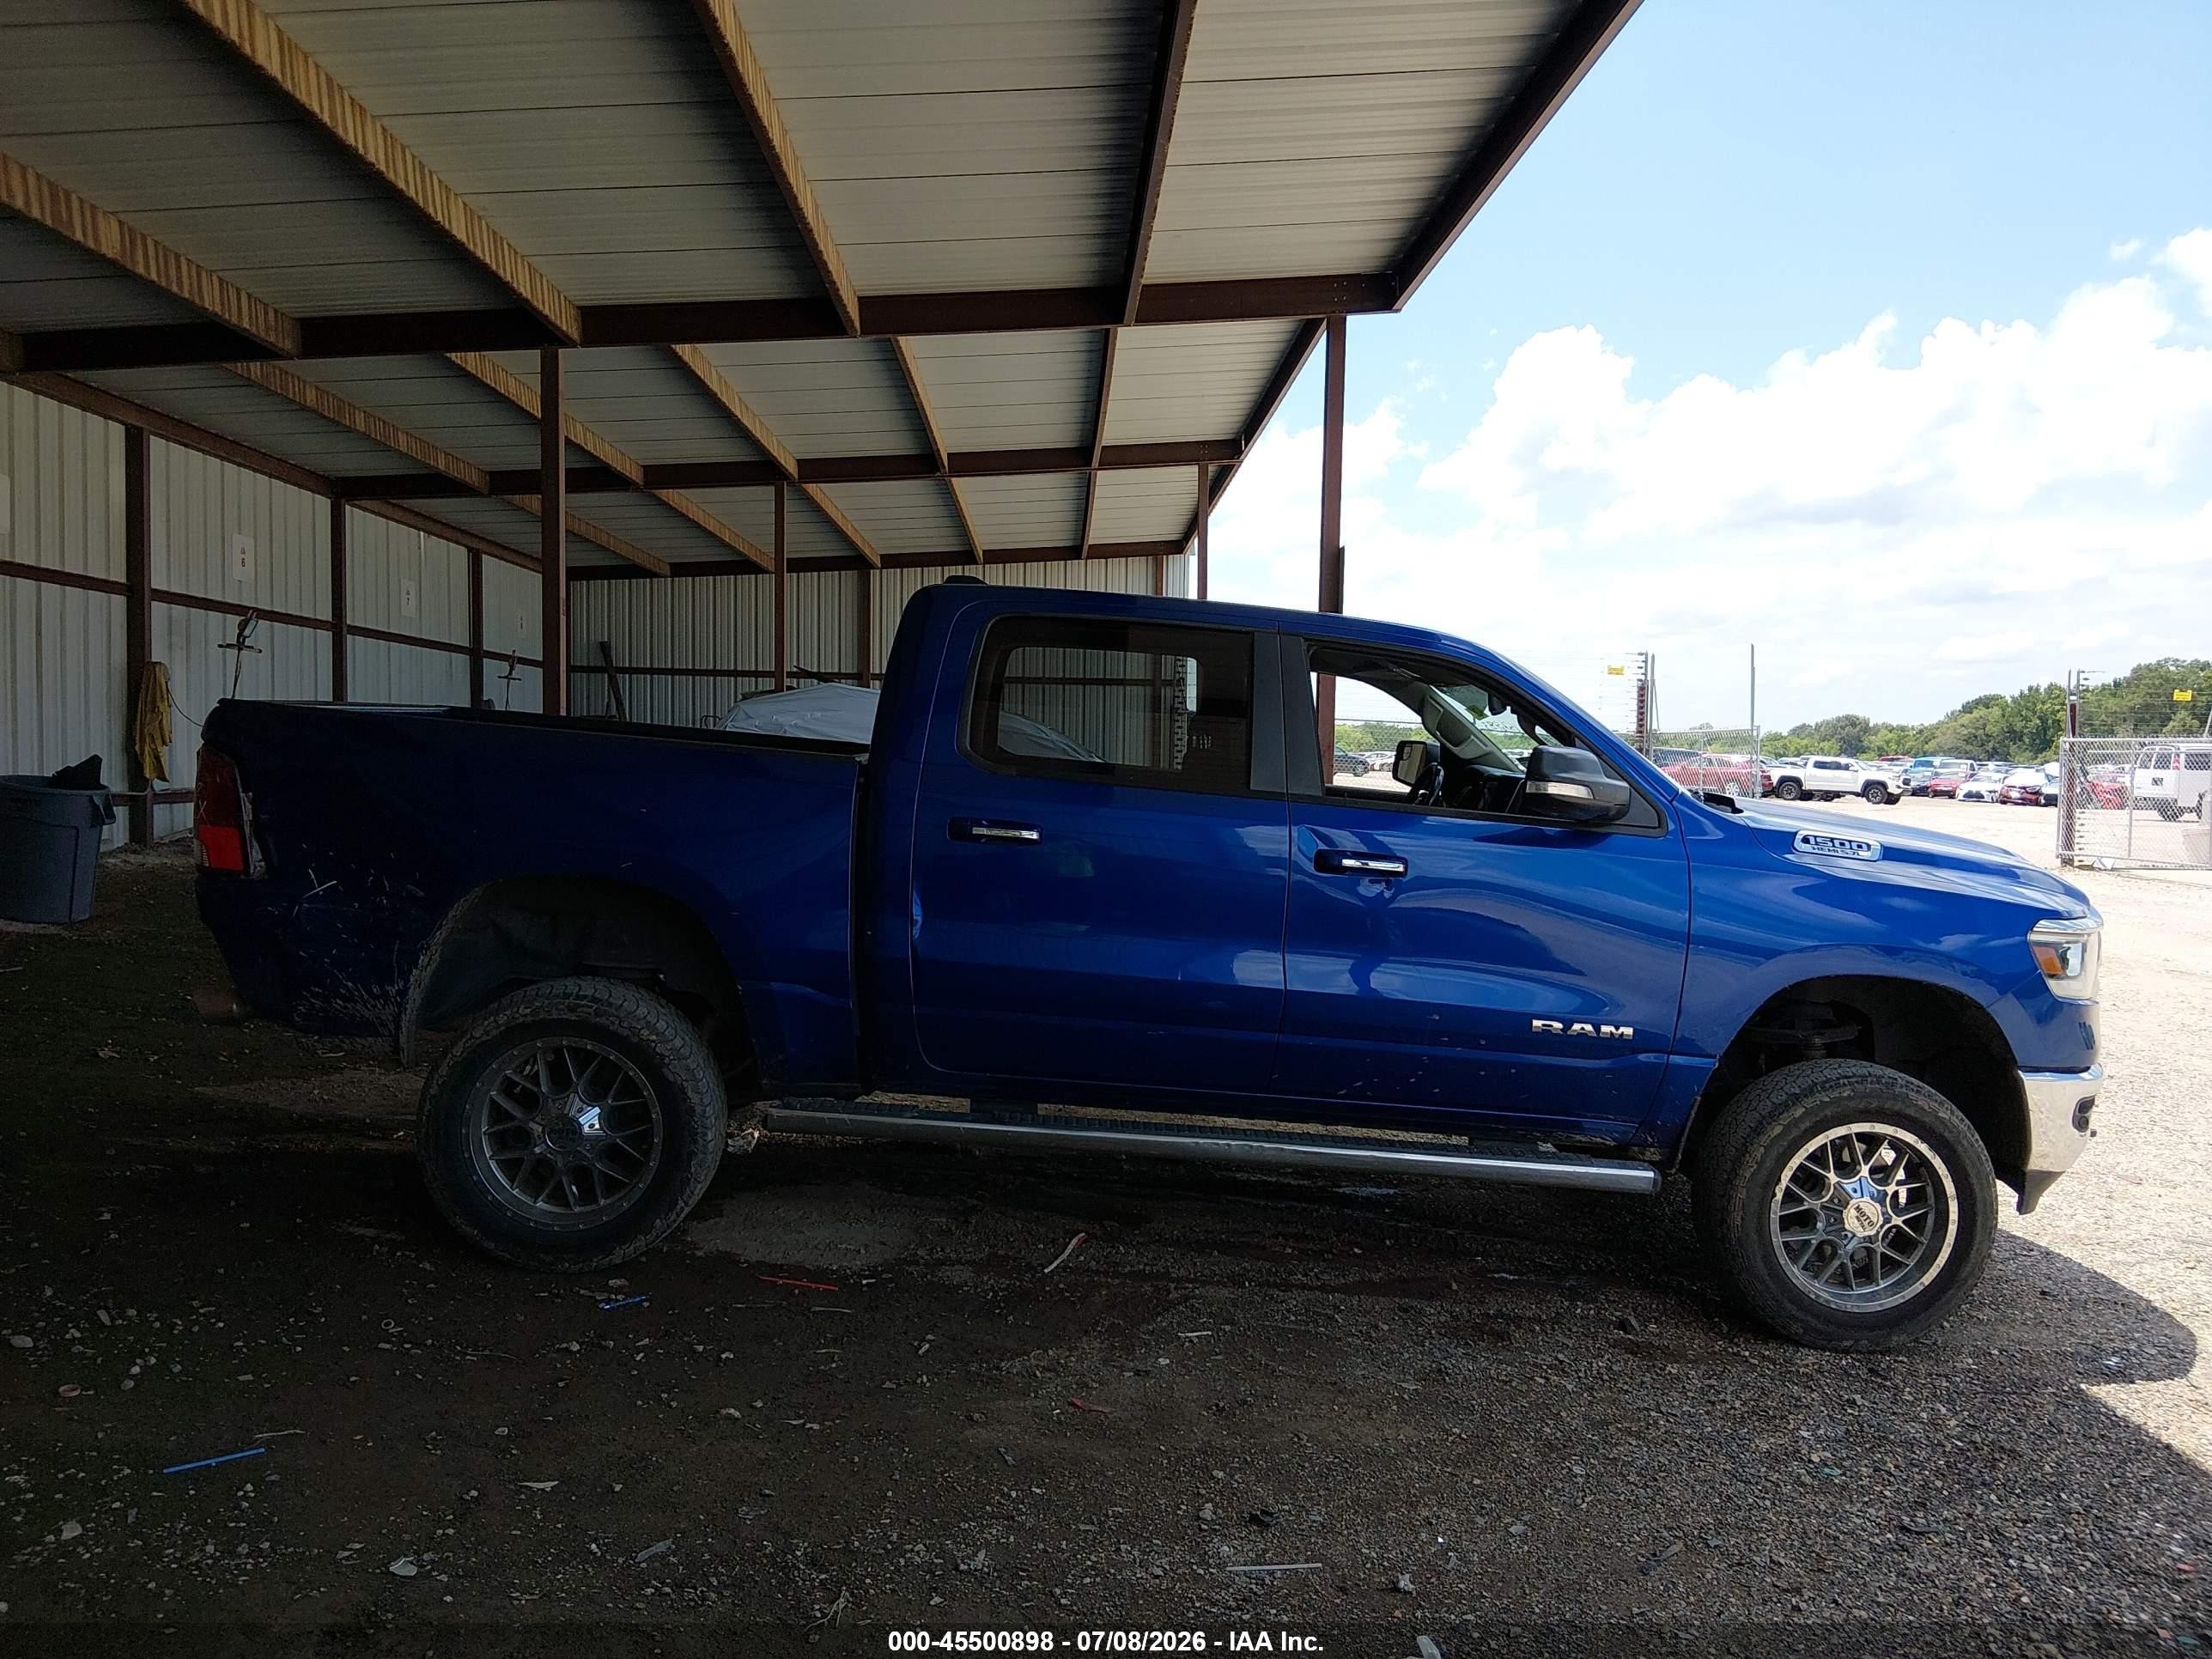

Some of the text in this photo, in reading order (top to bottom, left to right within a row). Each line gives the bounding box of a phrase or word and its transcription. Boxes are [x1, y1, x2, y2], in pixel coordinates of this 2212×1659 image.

[1804, 836, 1869, 851] 1500
[1531, 1019, 1634, 1040] RAM
[1853, 1204, 1875, 1227] MOTO
